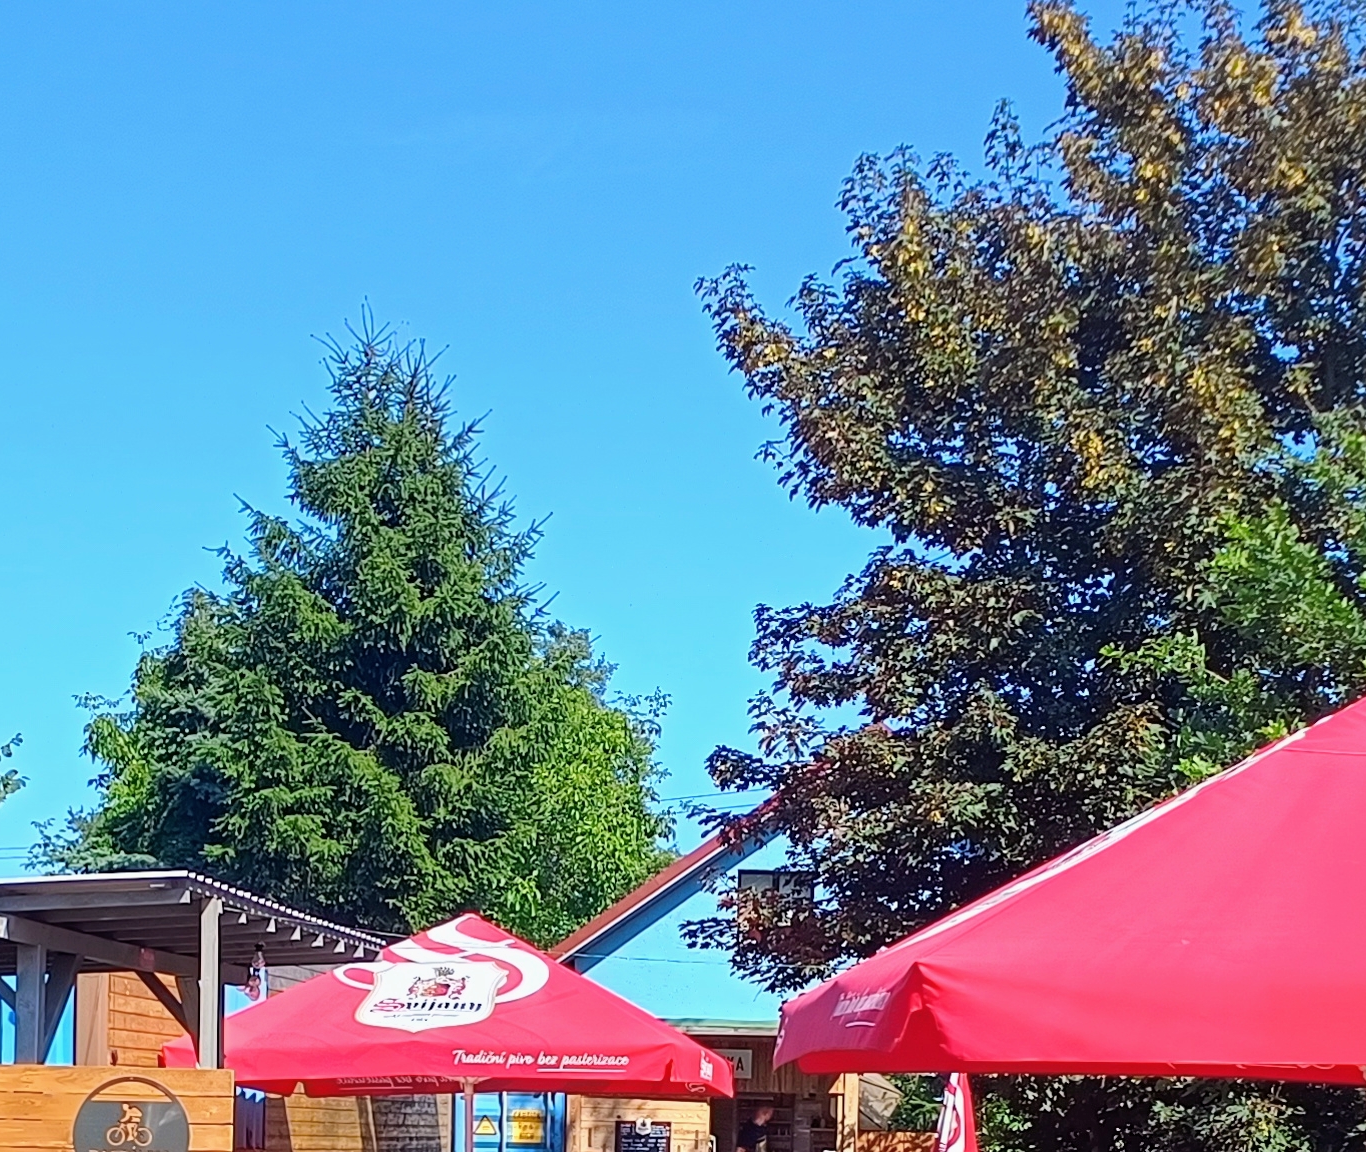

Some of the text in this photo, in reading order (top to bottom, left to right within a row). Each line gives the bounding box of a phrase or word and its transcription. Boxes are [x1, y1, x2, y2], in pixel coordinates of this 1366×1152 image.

[452, 1049, 630, 1069] Tradiční pivo bez pasterizace
